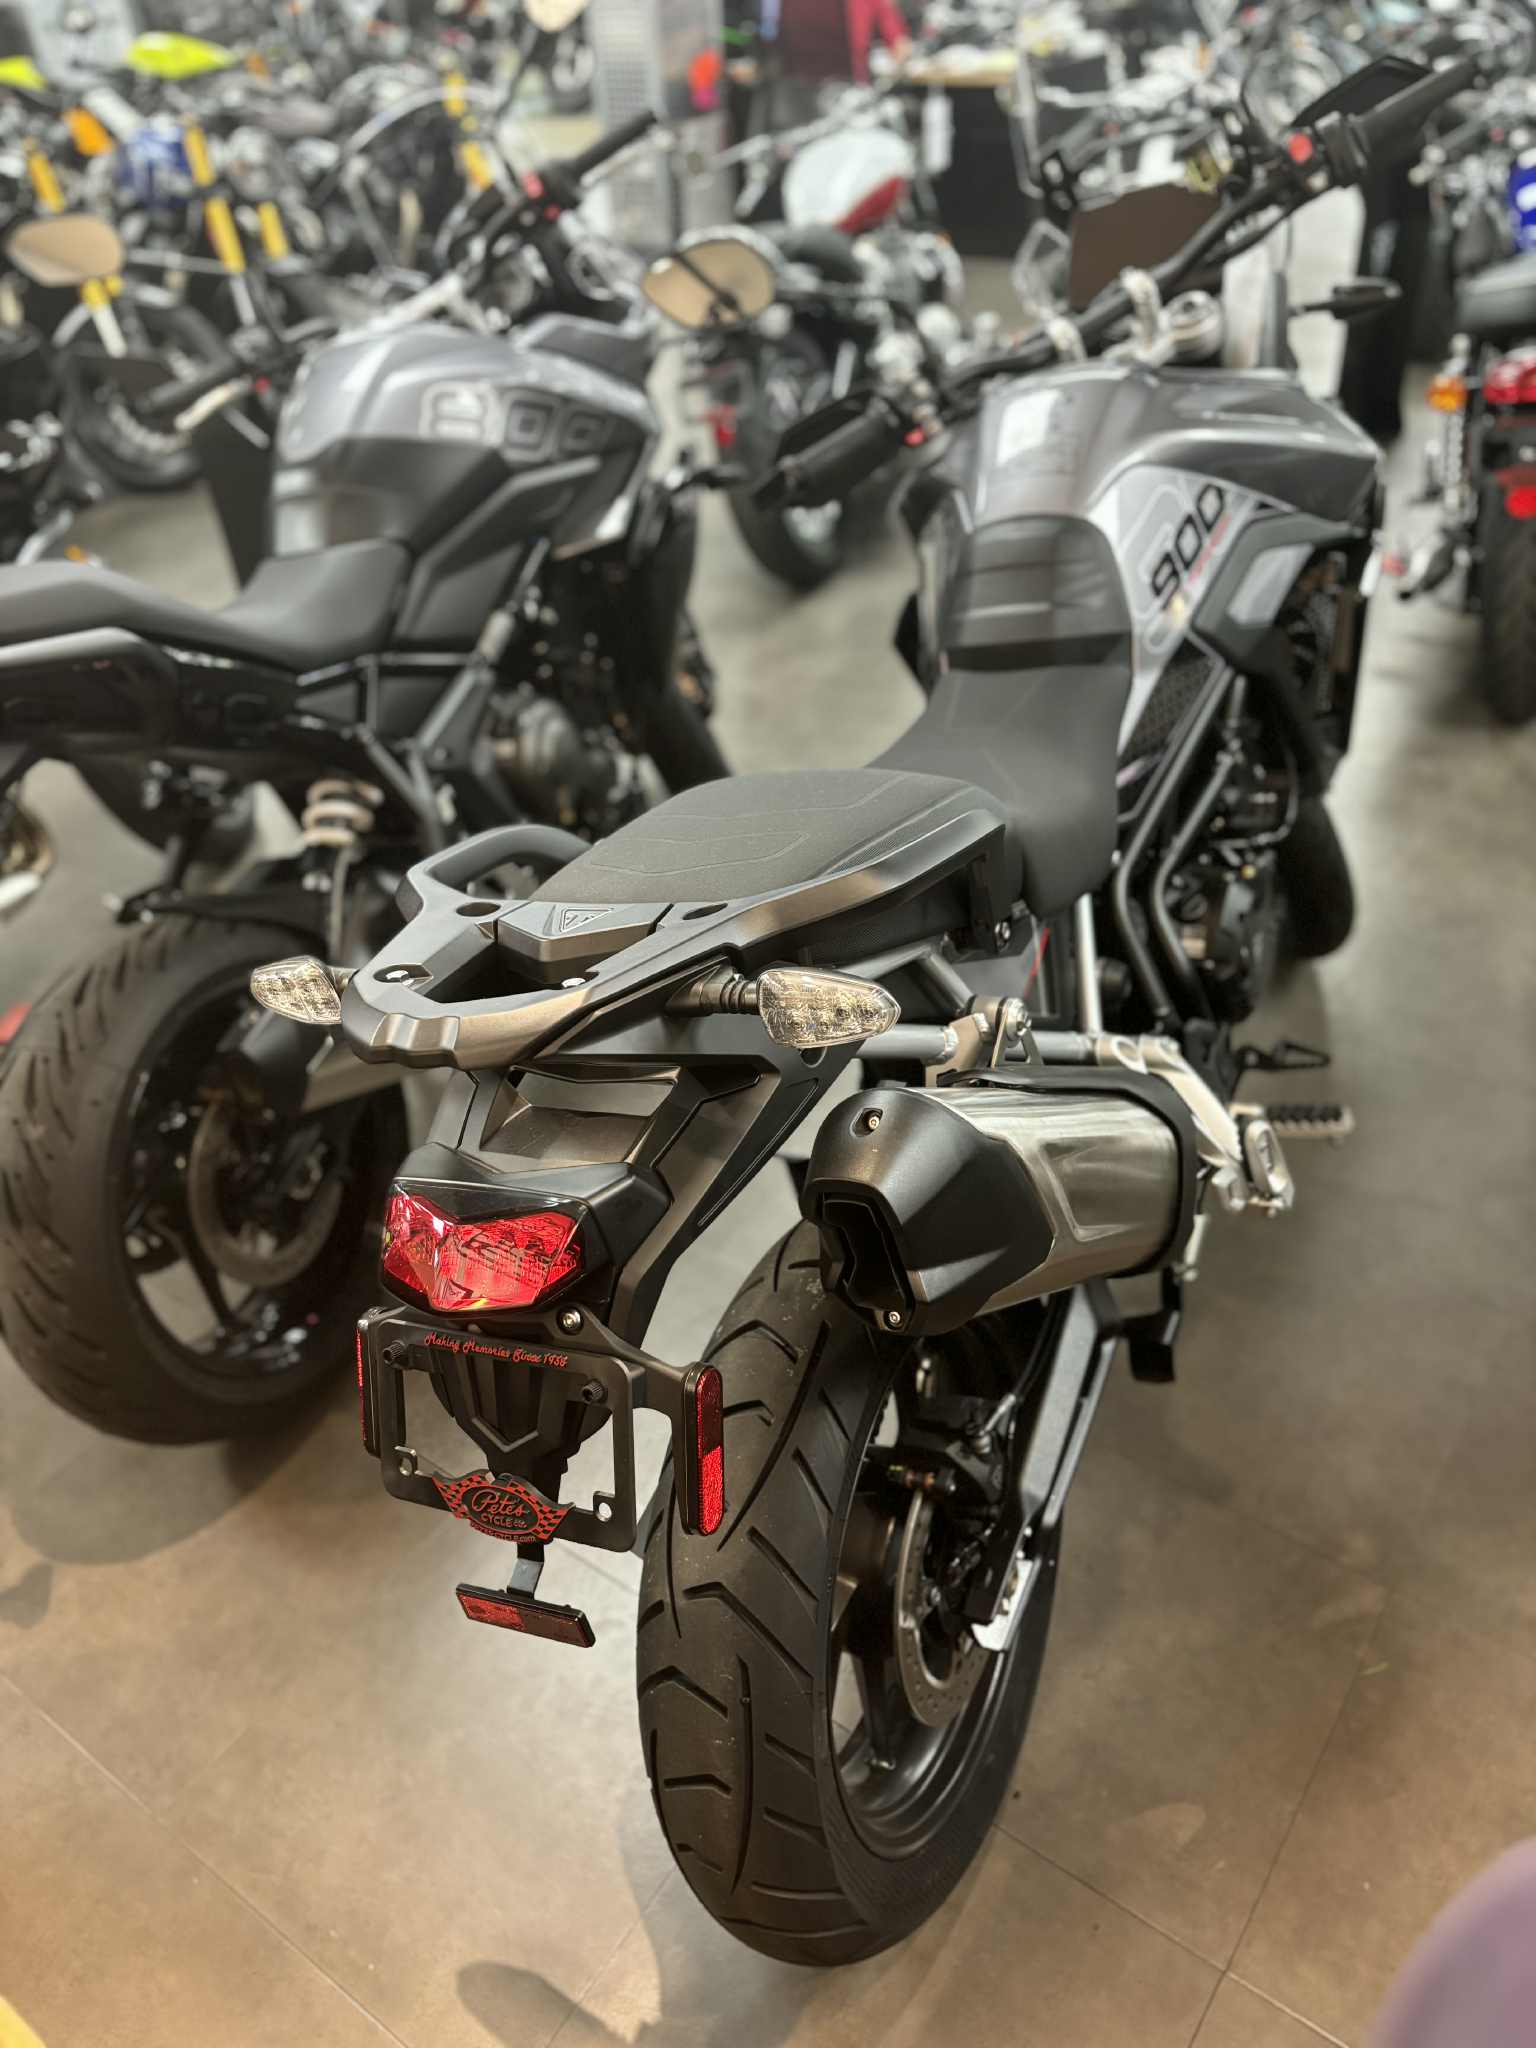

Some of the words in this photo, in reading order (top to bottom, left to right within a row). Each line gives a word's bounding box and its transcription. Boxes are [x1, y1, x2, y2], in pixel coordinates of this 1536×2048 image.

[1151, 483, 1225, 612] 900
[424, 1332, 460, 1352] Making
[462, 1340, 510, 1357] Memories
[512, 1348, 541, 1362] Since
[480, 1512, 512, 1527] CYCLE
